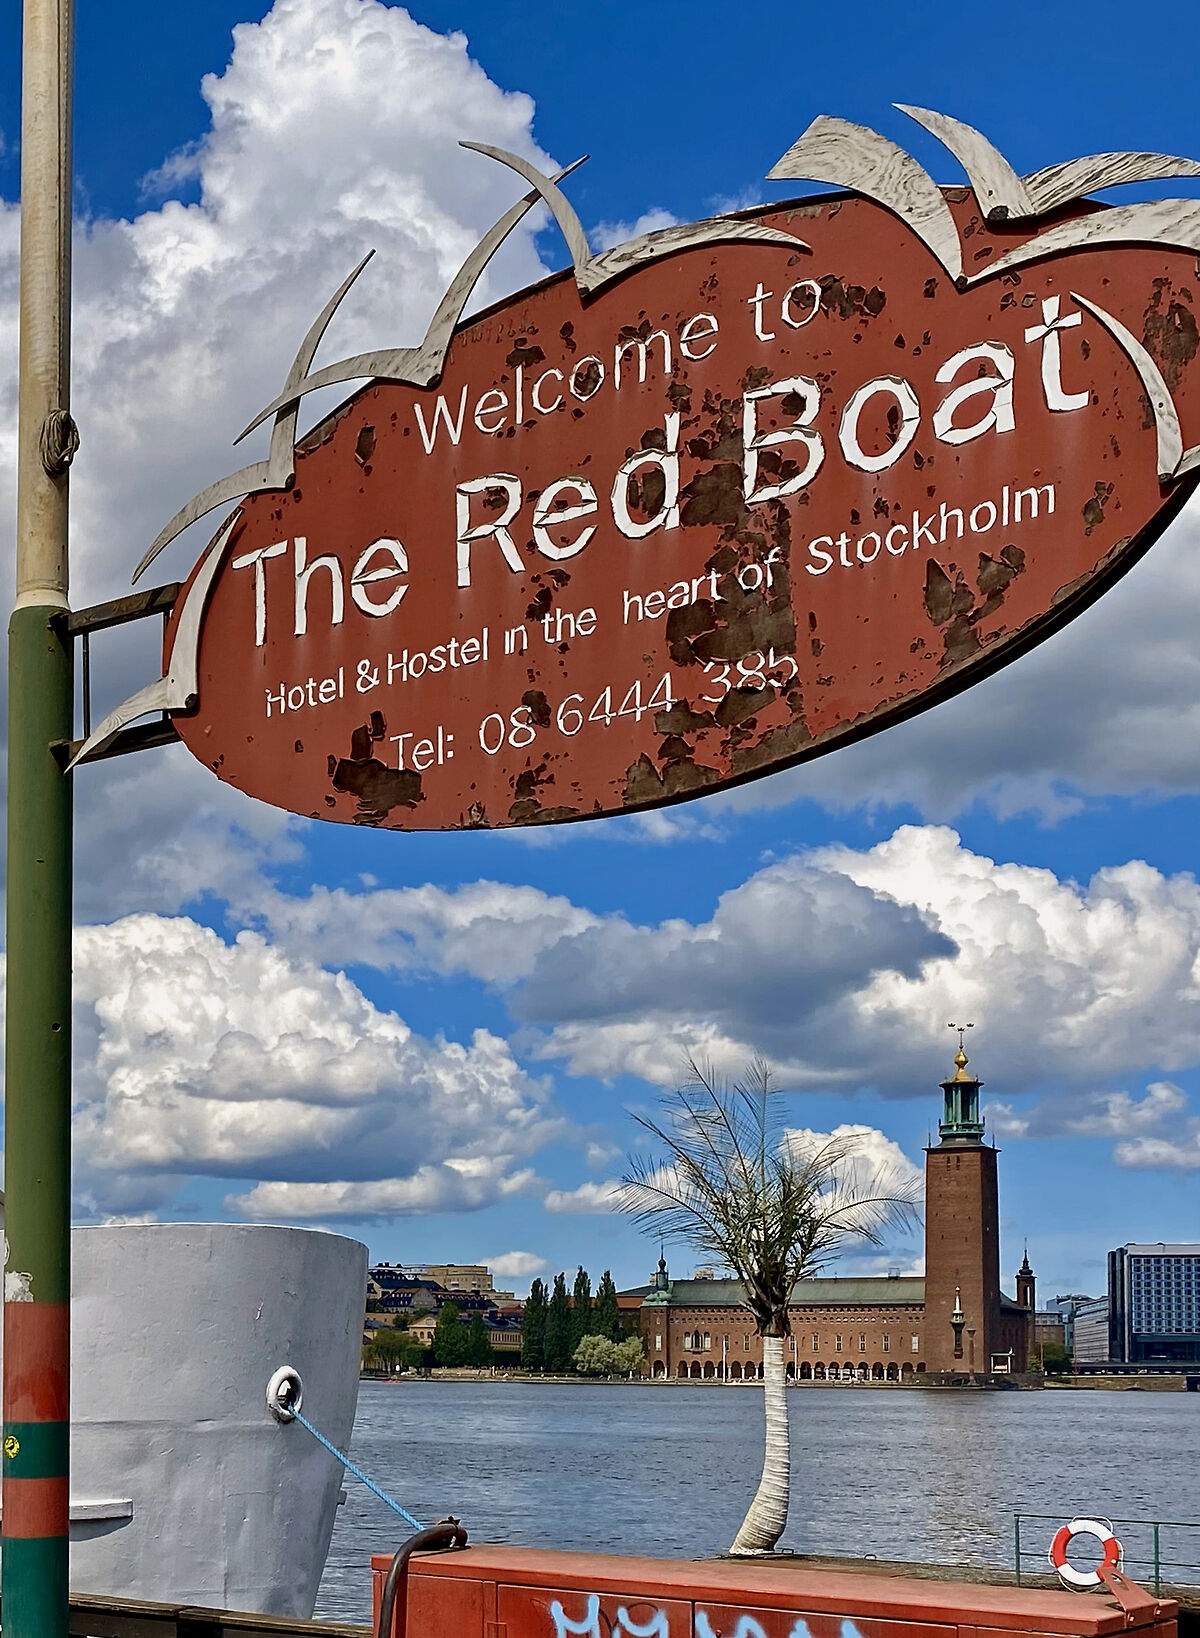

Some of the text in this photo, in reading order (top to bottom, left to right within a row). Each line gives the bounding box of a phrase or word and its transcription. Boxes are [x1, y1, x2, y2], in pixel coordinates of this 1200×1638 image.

[413, 278, 822, 456] Welcome to
[231, 294, 1090, 647] The Red Boat
[264, 483, 1056, 718] Hotel & Hostel in the heart of Stockholm
[389, 646, 799, 772] Tel: 08 6444 385
